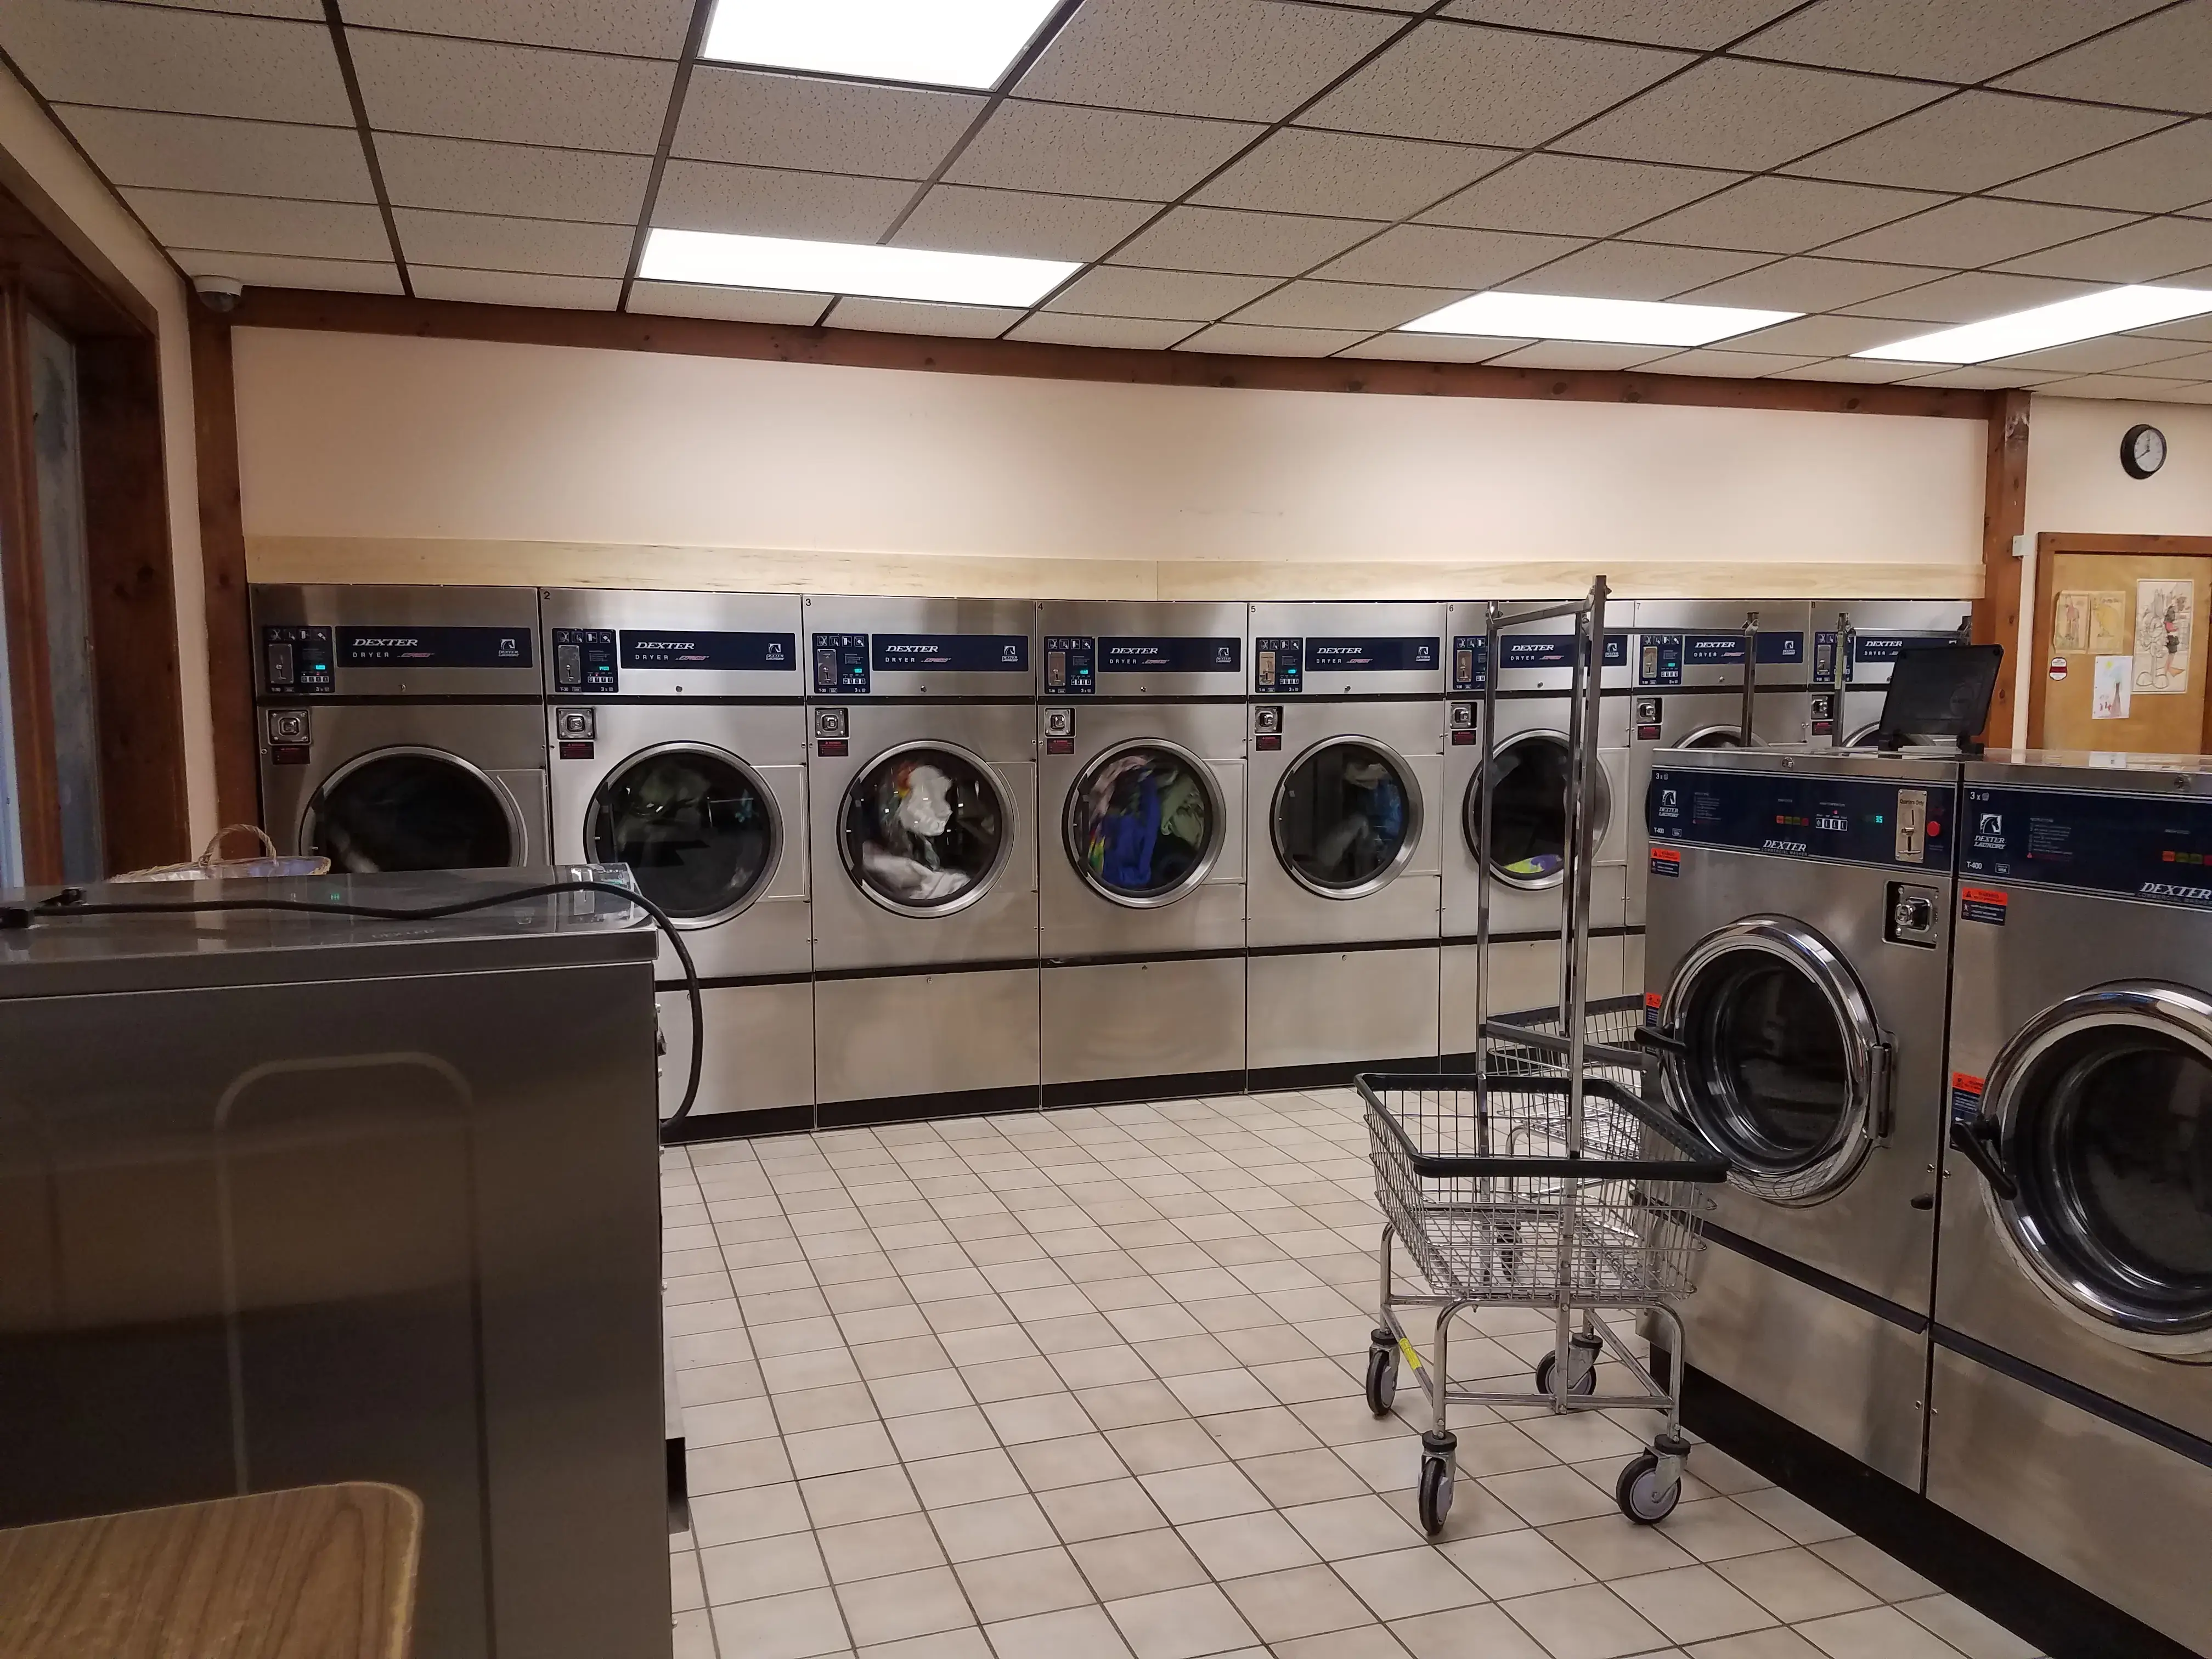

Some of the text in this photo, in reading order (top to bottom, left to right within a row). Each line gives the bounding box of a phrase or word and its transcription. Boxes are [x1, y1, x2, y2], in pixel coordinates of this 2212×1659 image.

[544, 591, 550, 600] 2
[805, 599, 811, 607] 3
[1970, 791, 1975, 800] 3
[1974, 836, 2005, 844] DEXTER
[1763, 839, 1807, 852] DEXTER
[1966, 861, 1983, 870] T-400
[2139, 882, 2212, 900] DEXTER
